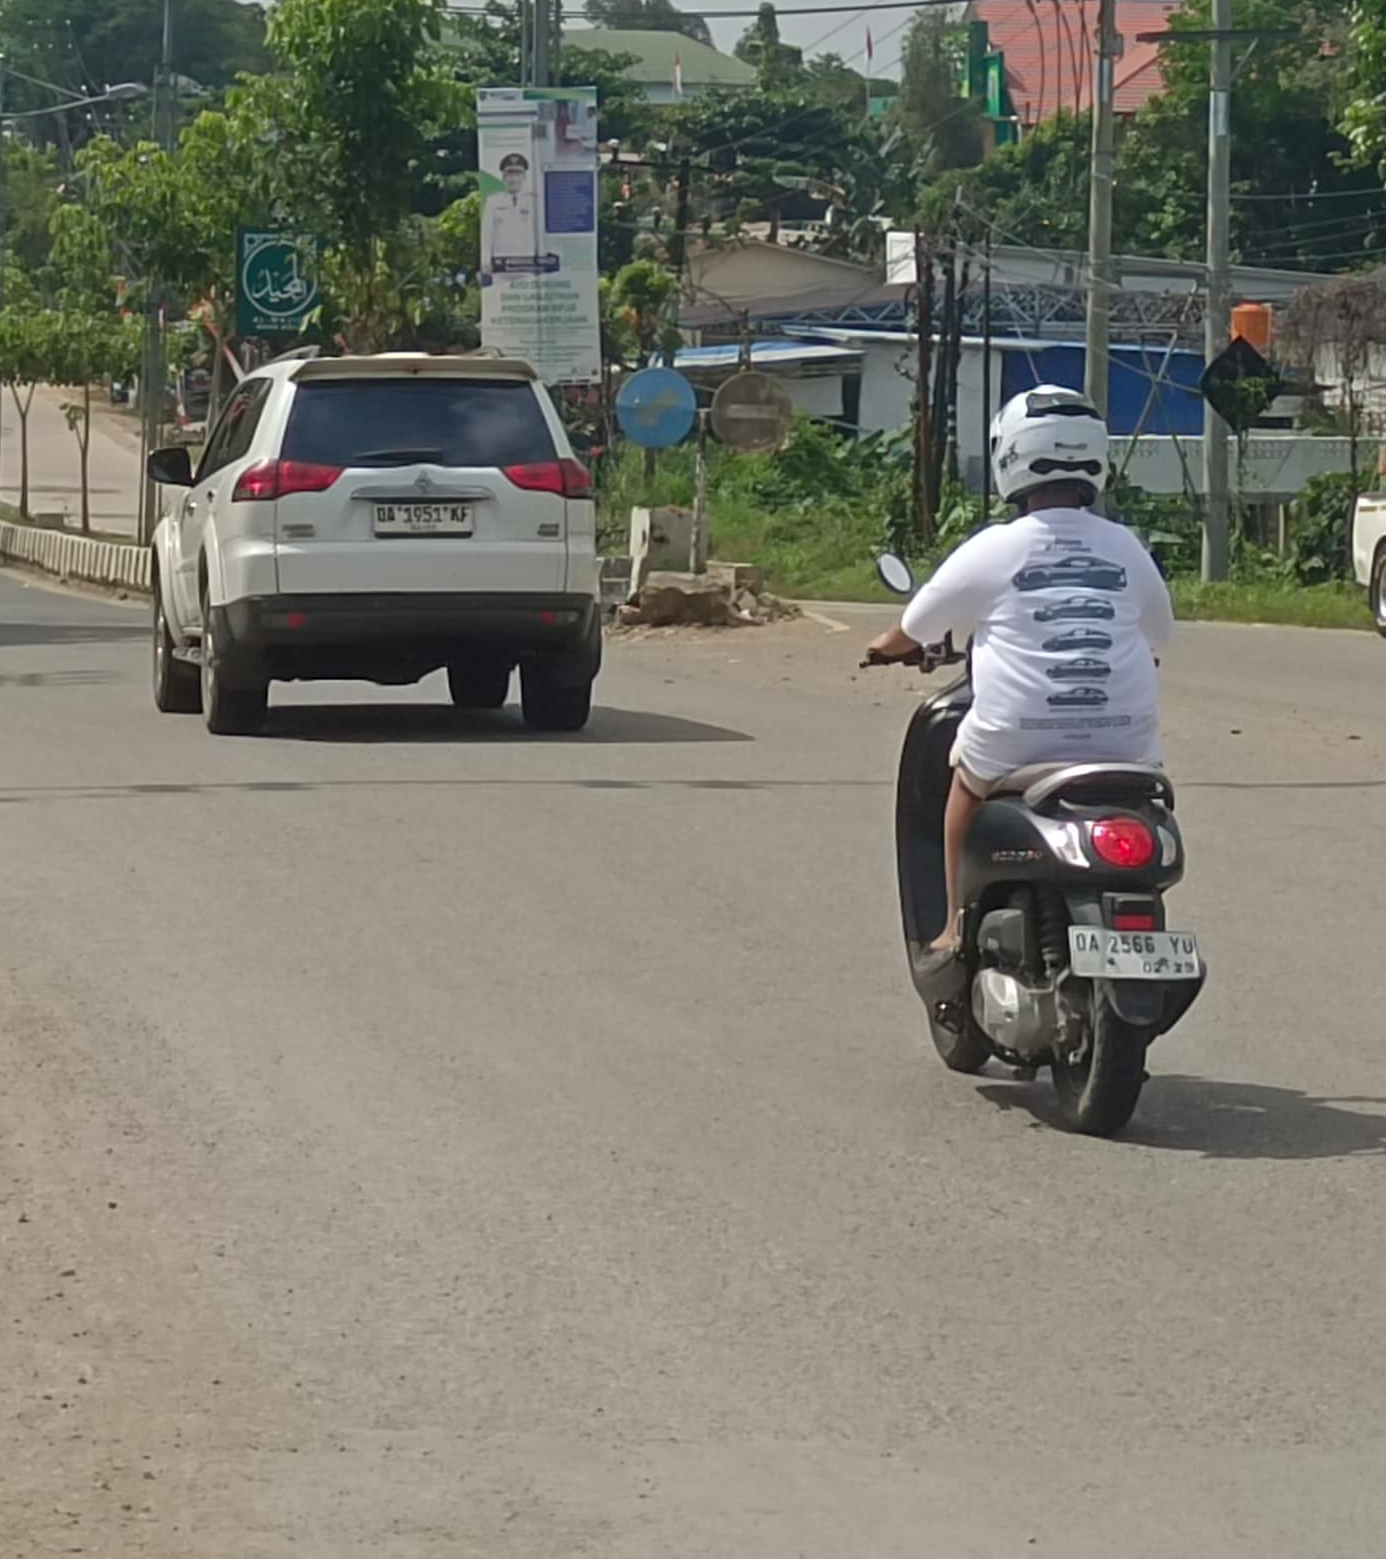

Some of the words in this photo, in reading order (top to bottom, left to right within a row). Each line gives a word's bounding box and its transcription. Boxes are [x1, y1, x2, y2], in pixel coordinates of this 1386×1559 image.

[376, 506, 396, 523] DA
[403, 506, 442, 523] 1951
[1076, 932, 1100, 953] DA
[1109, 935, 1155, 954] 2566
[1169, 935, 1194, 954] YU
